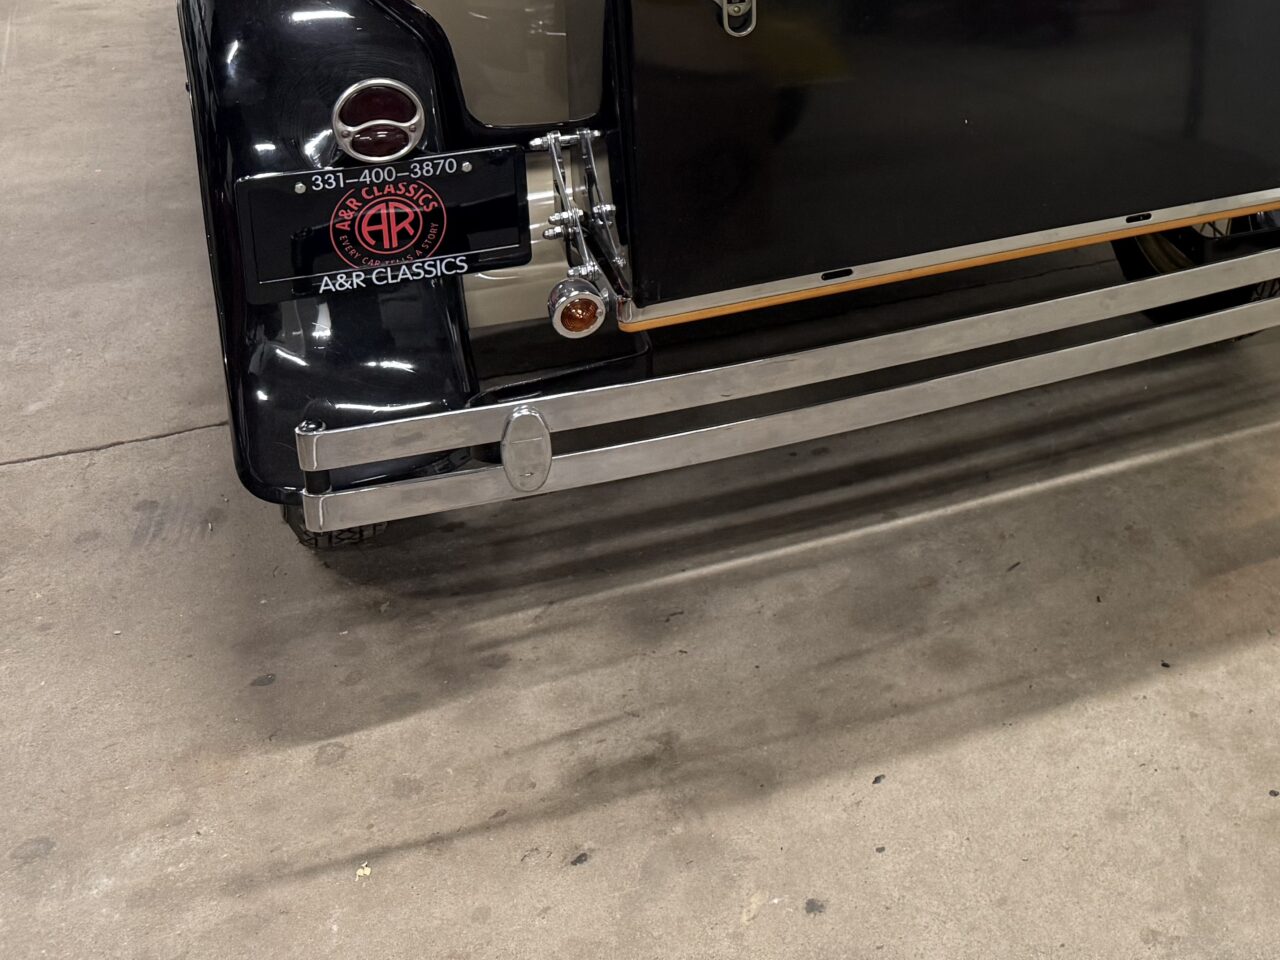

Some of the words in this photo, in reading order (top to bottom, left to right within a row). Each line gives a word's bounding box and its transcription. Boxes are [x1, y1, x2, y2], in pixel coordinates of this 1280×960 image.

[311, 158, 457, 191] 331-400-3870
[335, 197, 363, 231] A&R
[361, 182, 439, 212] CLASSICS
[340, 234, 362, 259] EVERY
[362, 257, 381, 267] CAR
[416, 249, 423, 257] A
[421, 222, 439, 249] STORY
[318, 271, 367, 294] A&R
[371, 256, 468, 286] CLASSICS
